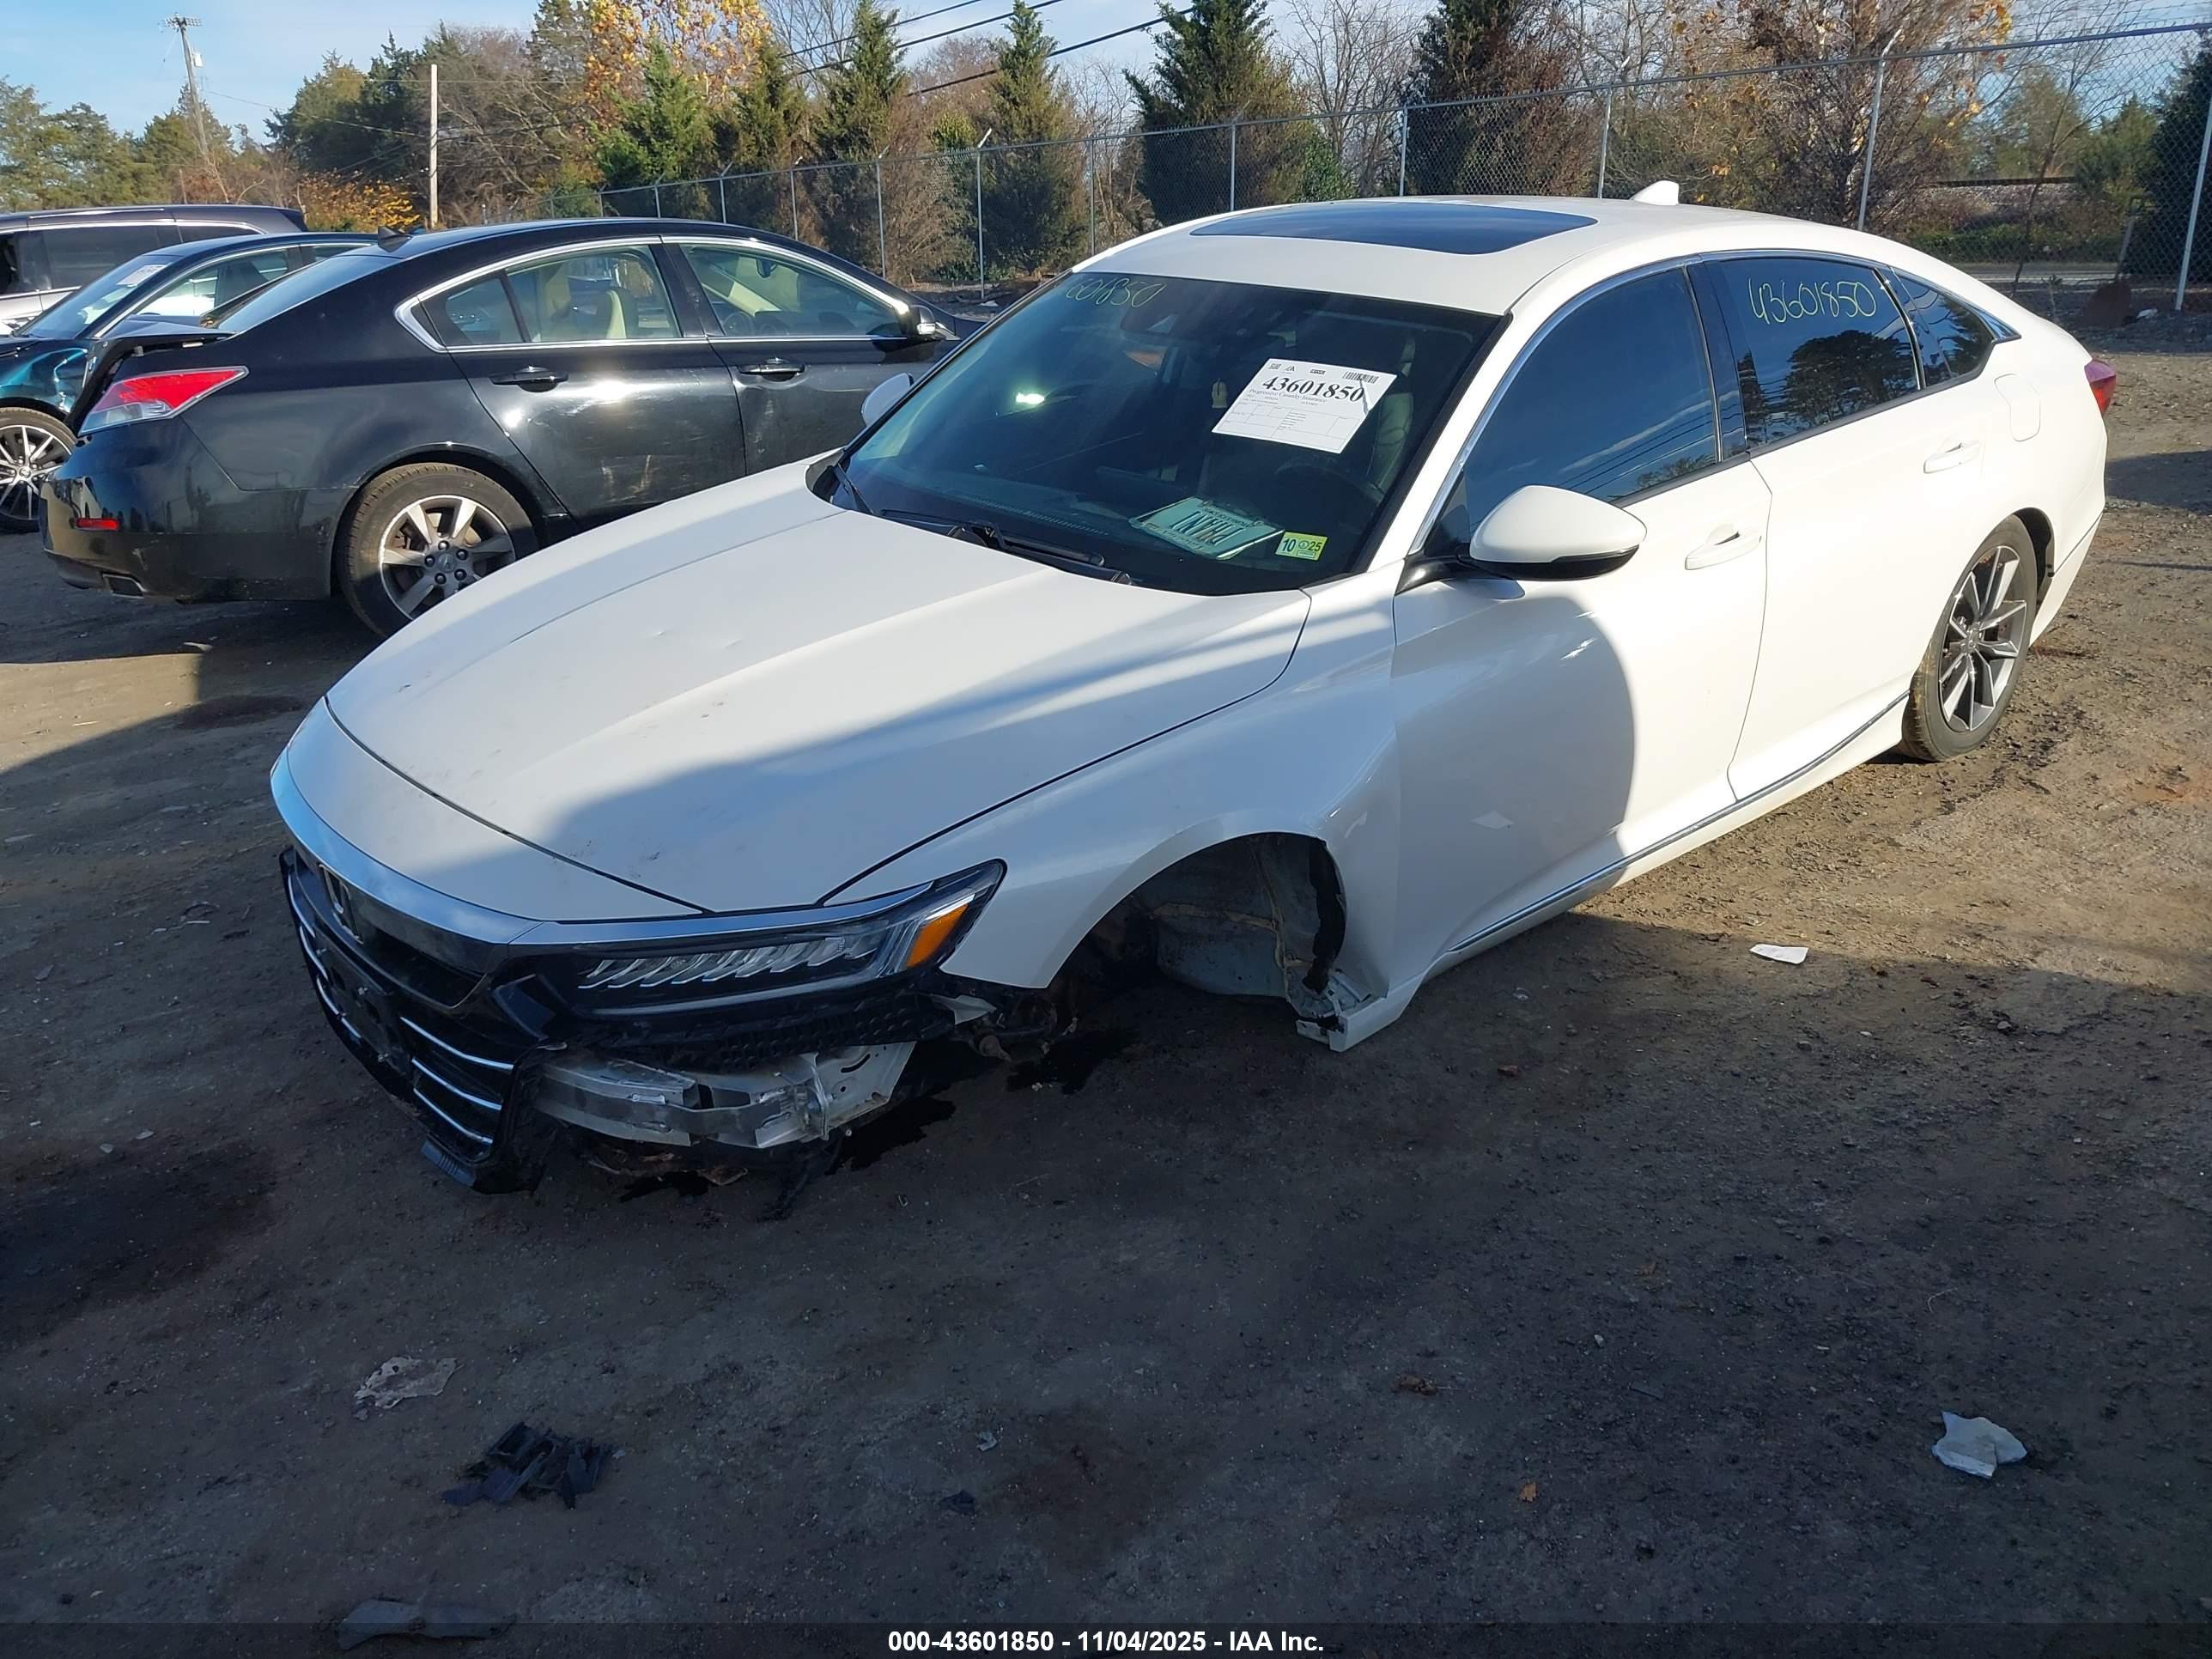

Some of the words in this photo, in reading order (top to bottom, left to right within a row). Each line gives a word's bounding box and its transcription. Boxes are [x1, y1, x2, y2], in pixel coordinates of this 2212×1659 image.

[1748, 276, 1877, 325] 43601850
[1261, 376, 1364, 403] 43601850
[1282, 538, 1297, 552] 10
[1308, 541, 1322, 552] 25
